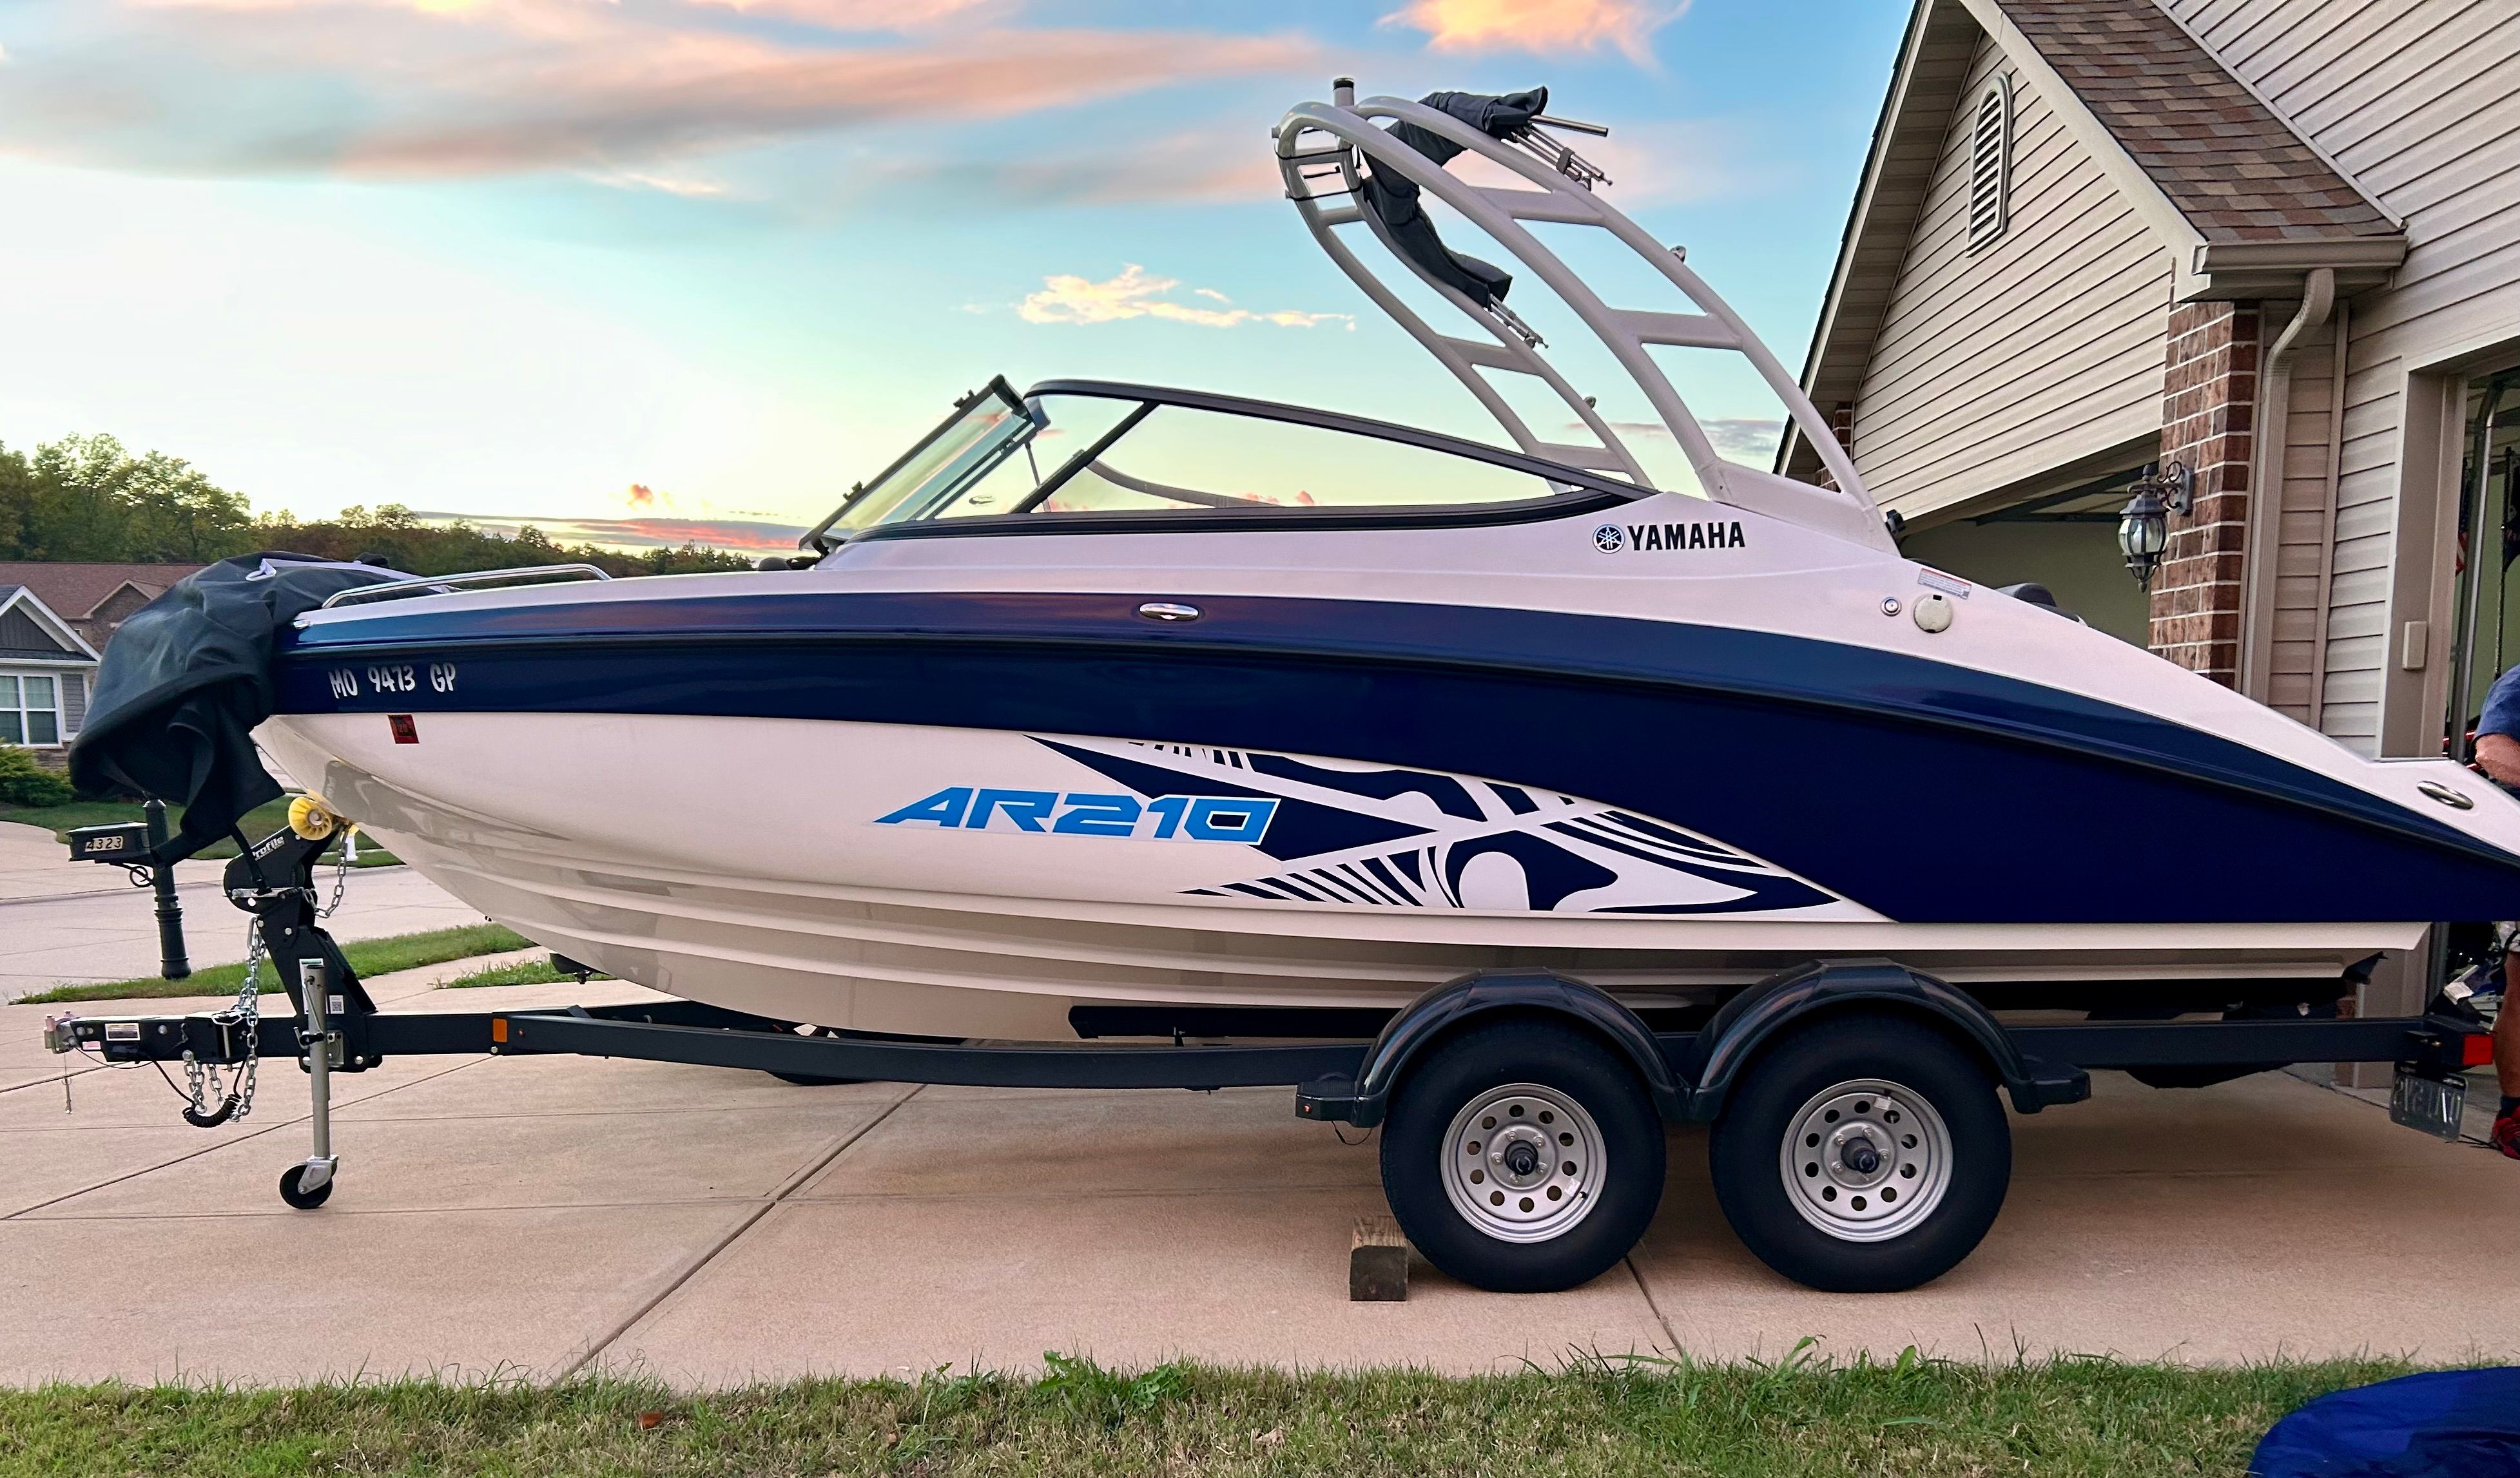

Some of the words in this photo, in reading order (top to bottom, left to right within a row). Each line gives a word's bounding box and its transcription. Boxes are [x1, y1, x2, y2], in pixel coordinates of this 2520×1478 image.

[1627, 522, 1745, 551] YAMAHA
[328, 668, 358, 698] MO
[368, 665, 416, 692] 9473
[430, 662, 456, 692] GP
[872, 787, 1280, 845] AR210
[86, 838, 121, 850] 4323
